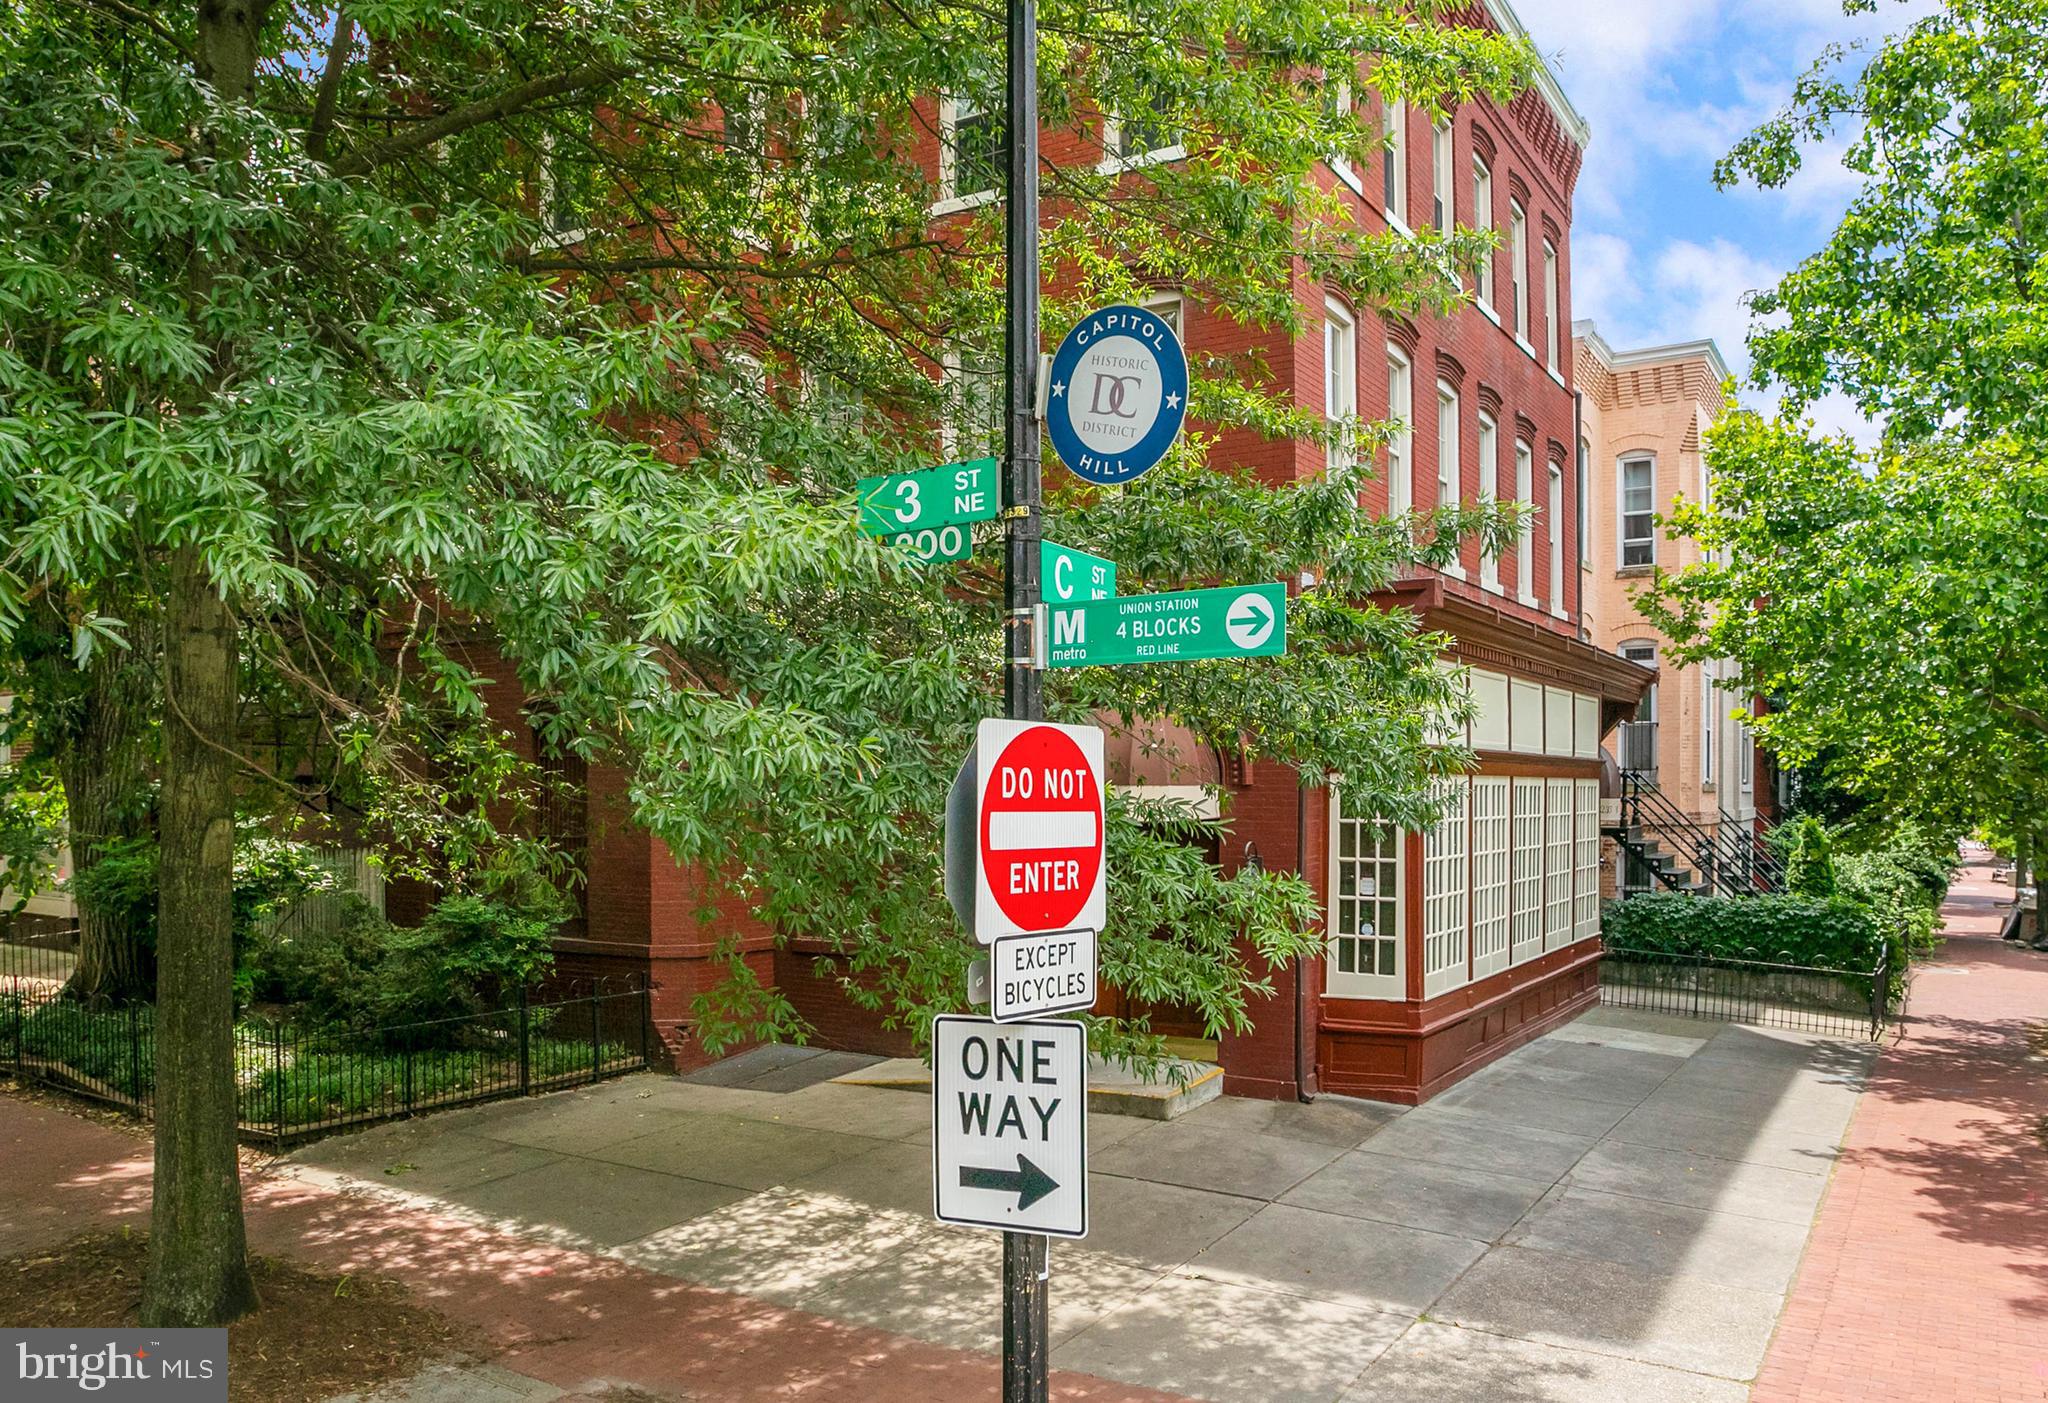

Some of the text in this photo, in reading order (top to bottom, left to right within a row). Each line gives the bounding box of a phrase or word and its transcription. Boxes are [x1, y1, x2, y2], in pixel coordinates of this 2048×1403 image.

[1076, 314, 1166, 351] CAPITOL
[1091, 354, 1150, 371] HISTORIC
[1088, 372, 1142, 419] DC
[1082, 420, 1138, 439] DISTRICT
[1079, 454, 1130, 475] HILL
[895, 468, 982, 523] 3 ST
[954, 491, 985, 514] NE
[1054, 554, 1106, 600] C ST
[1119, 597, 1199, 616] UNION STATION
[1054, 609, 1085, 645] M
[1116, 616, 1201, 639] 4 BLOCKS
[1052, 648, 1087, 662] metro
[1136, 643, 1180, 656] RED LINE
[1001, 767, 1087, 799] DO NOT
[1009, 860, 1080, 895] ENTER
[1015, 942, 1077, 971] EXCEPT
[1005, 972, 1086, 1005] BICYCLES
[961, 1036, 1057, 1085] ONE
[958, 1091, 1062, 1142] WAY
